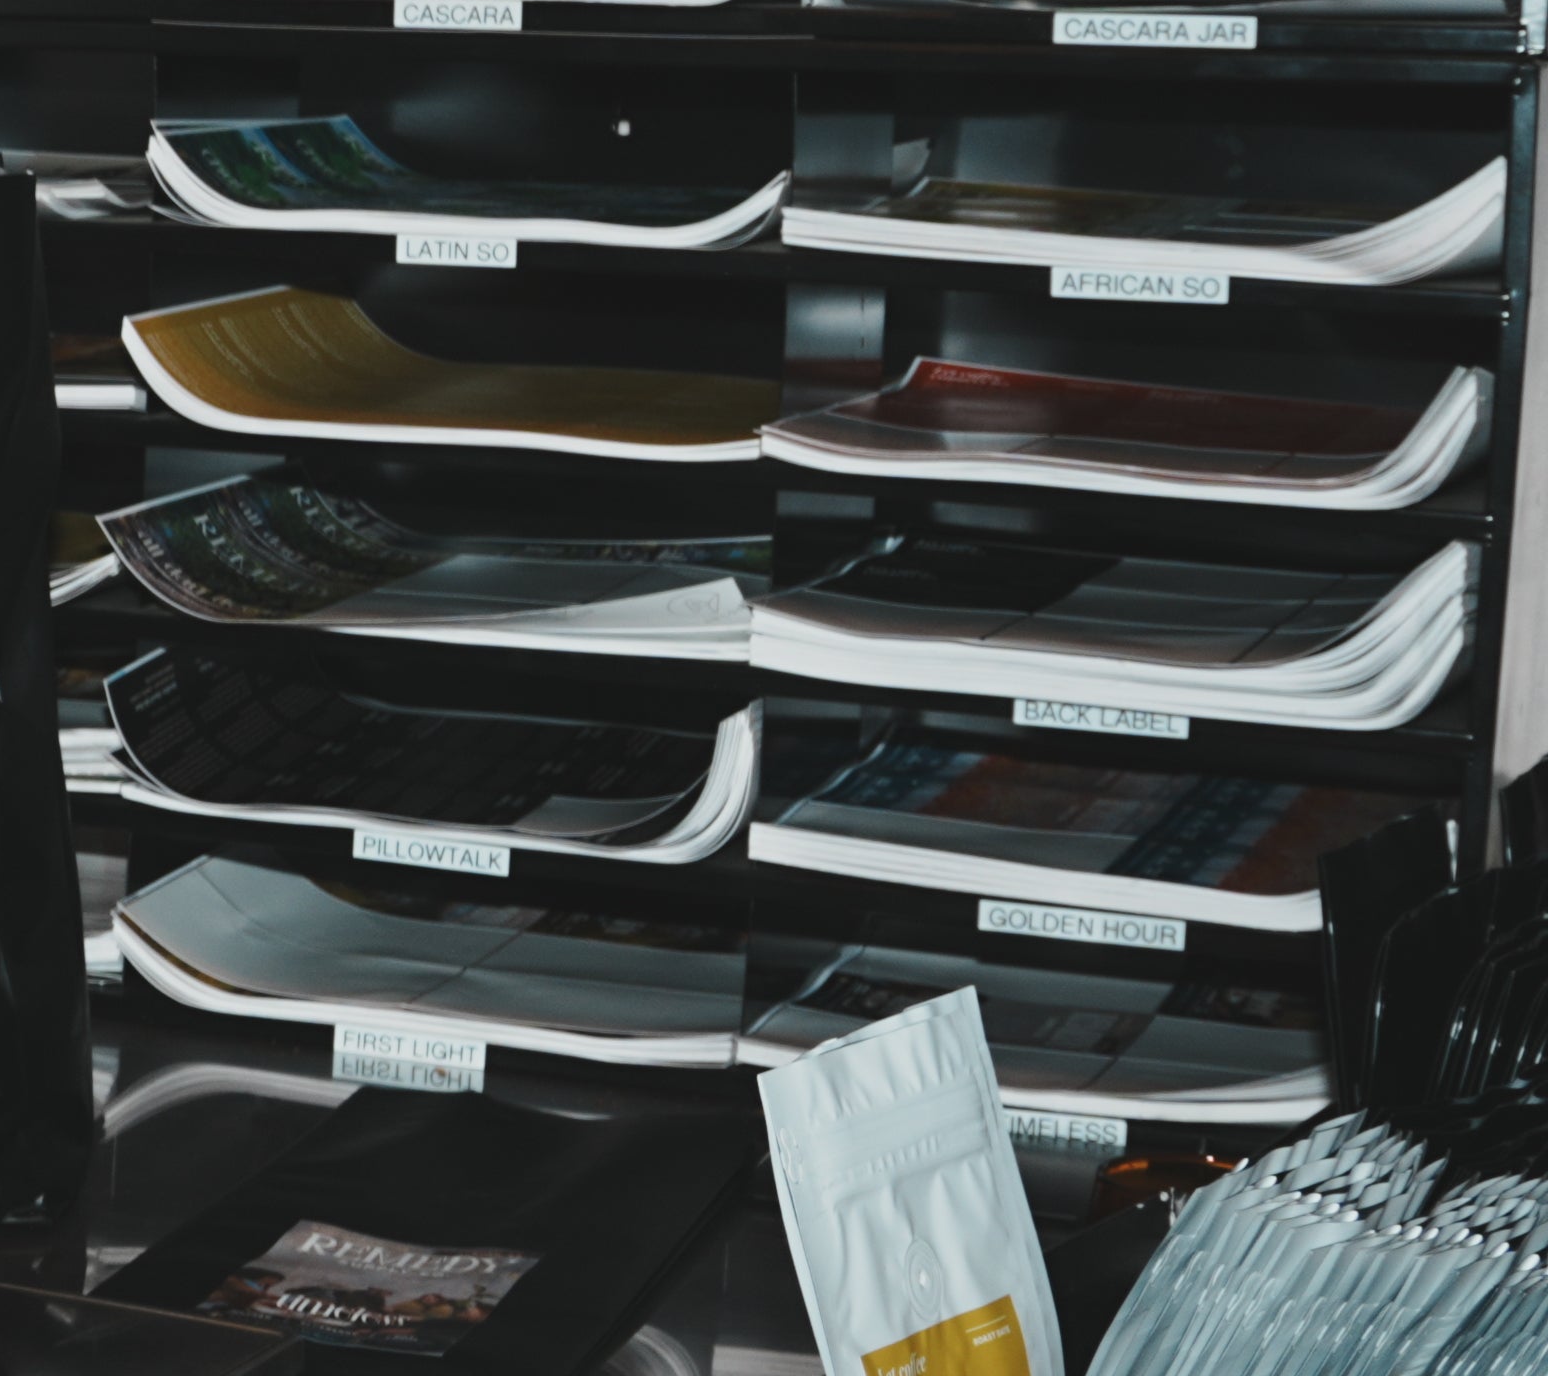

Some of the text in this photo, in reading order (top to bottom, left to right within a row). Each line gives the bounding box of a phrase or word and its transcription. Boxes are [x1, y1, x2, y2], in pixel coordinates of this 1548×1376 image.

[402, 3, 514, 25] CASCARA
[1063, 18, 1248, 44] CASCARA JAR
[406, 239, 510, 263] LATIN SO
[1060, 272, 1221, 298] AFRICAN SO
[1023, 700, 1183, 734] BACK LABEL
[363, 836, 502, 871] PILLOWTALK
[988, 907, 1178, 946] GOLDEN HOUR
[343, 1029, 478, 1064] FIRST LIGHT
[1005, 1113, 1118, 1144] IMELESS
[298, 1232, 519, 1275] REMEDY
